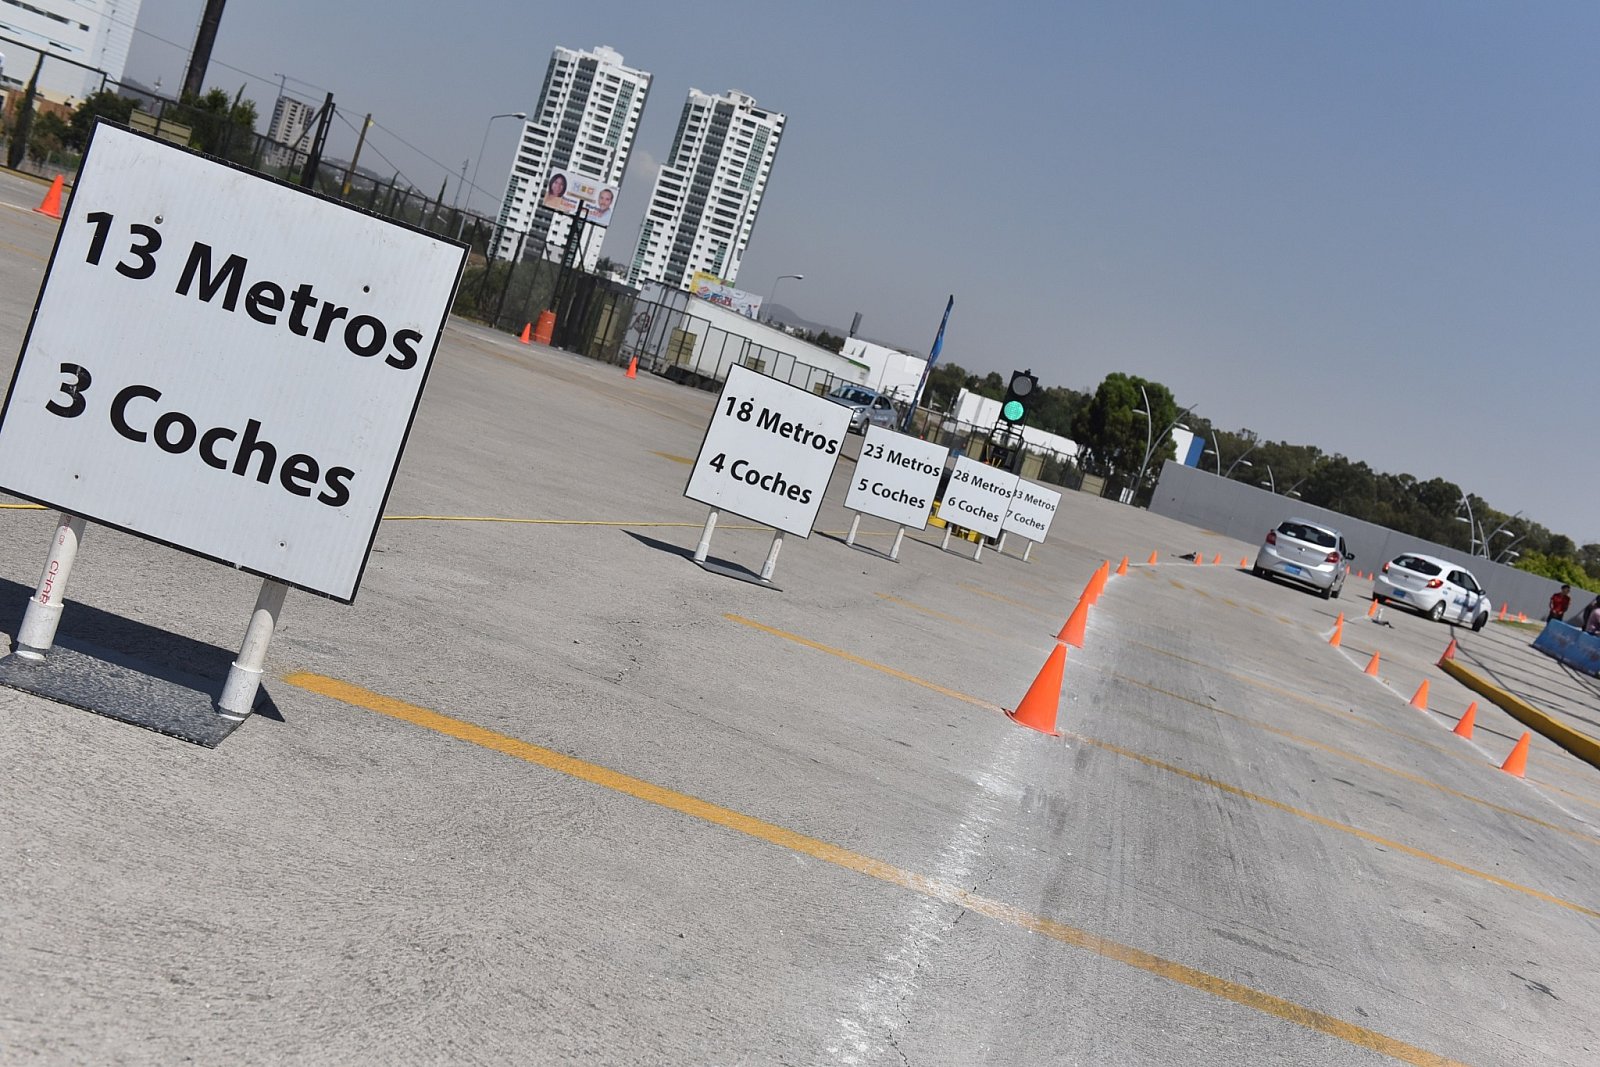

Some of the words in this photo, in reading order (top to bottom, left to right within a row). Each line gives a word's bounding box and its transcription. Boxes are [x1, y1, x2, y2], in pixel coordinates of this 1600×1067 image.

[86, 211, 163, 280] 13
[175, 242, 424, 371] Metros
[46, 363, 92, 419] 3
[110, 385, 356, 508] Coches
[725, 396, 754, 423] 18
[756, 407, 839, 455] Metros
[863, 443, 885, 460] 23
[887, 449, 941, 478] Metros
[709, 452, 727, 474] 4
[730, 460, 813, 506] Coches
[857, 477, 869, 492] 5
[871, 482, 926, 509] Coches
[953, 469, 970, 483] 28
[970, 475, 1012, 499] Metros
[948, 496, 957, 507] 6
[957, 499, 1000, 524] Coches
[1024, 493, 1056, 512] Metros
[1006, 509, 1014, 519] 7
[1013, 512, 1046, 531] Coches
